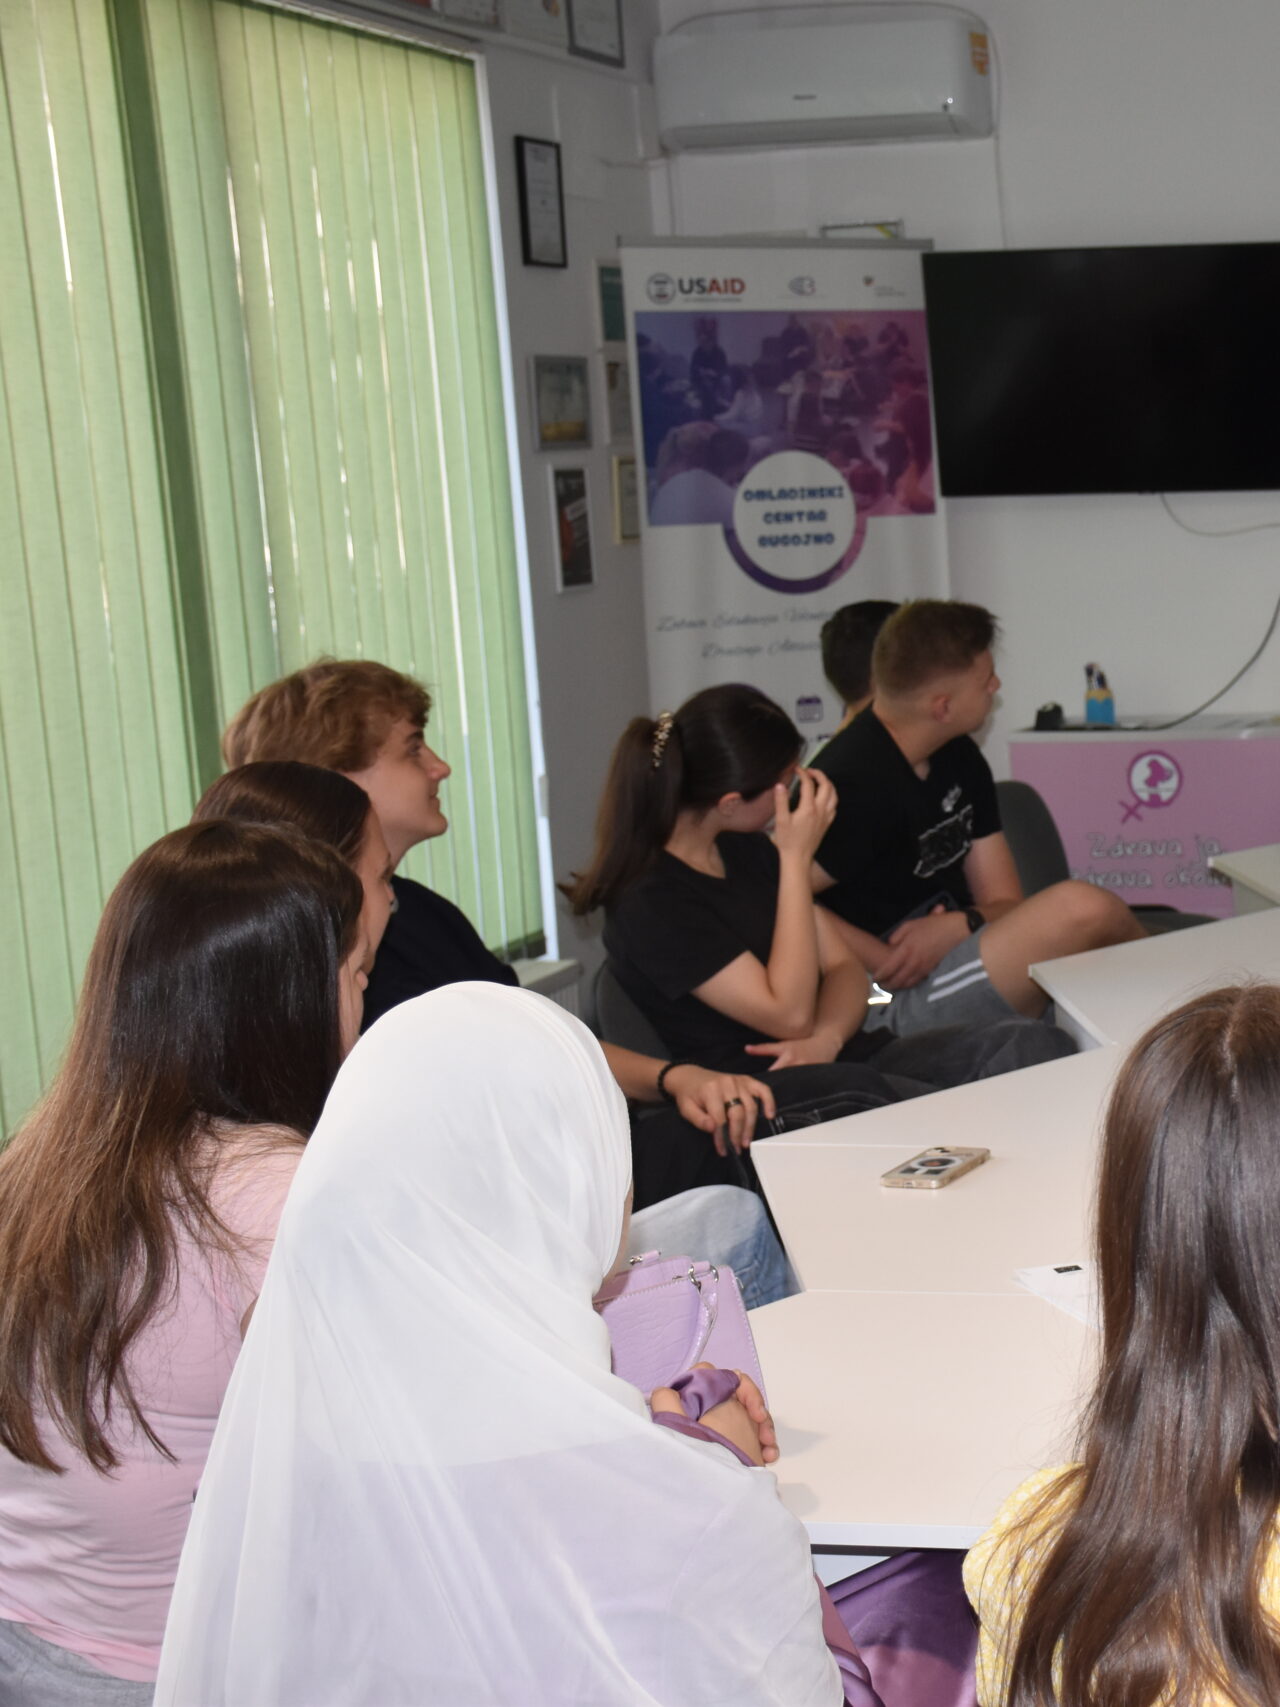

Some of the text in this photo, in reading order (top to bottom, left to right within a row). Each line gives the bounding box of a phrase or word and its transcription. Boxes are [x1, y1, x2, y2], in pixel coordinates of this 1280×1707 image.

[678, 276, 746, 296] USAID
[743, 485, 844, 502] OMLADINSKI
[763, 509, 827, 525] CENTAR
[757, 532, 835, 548] BUGOJNO
